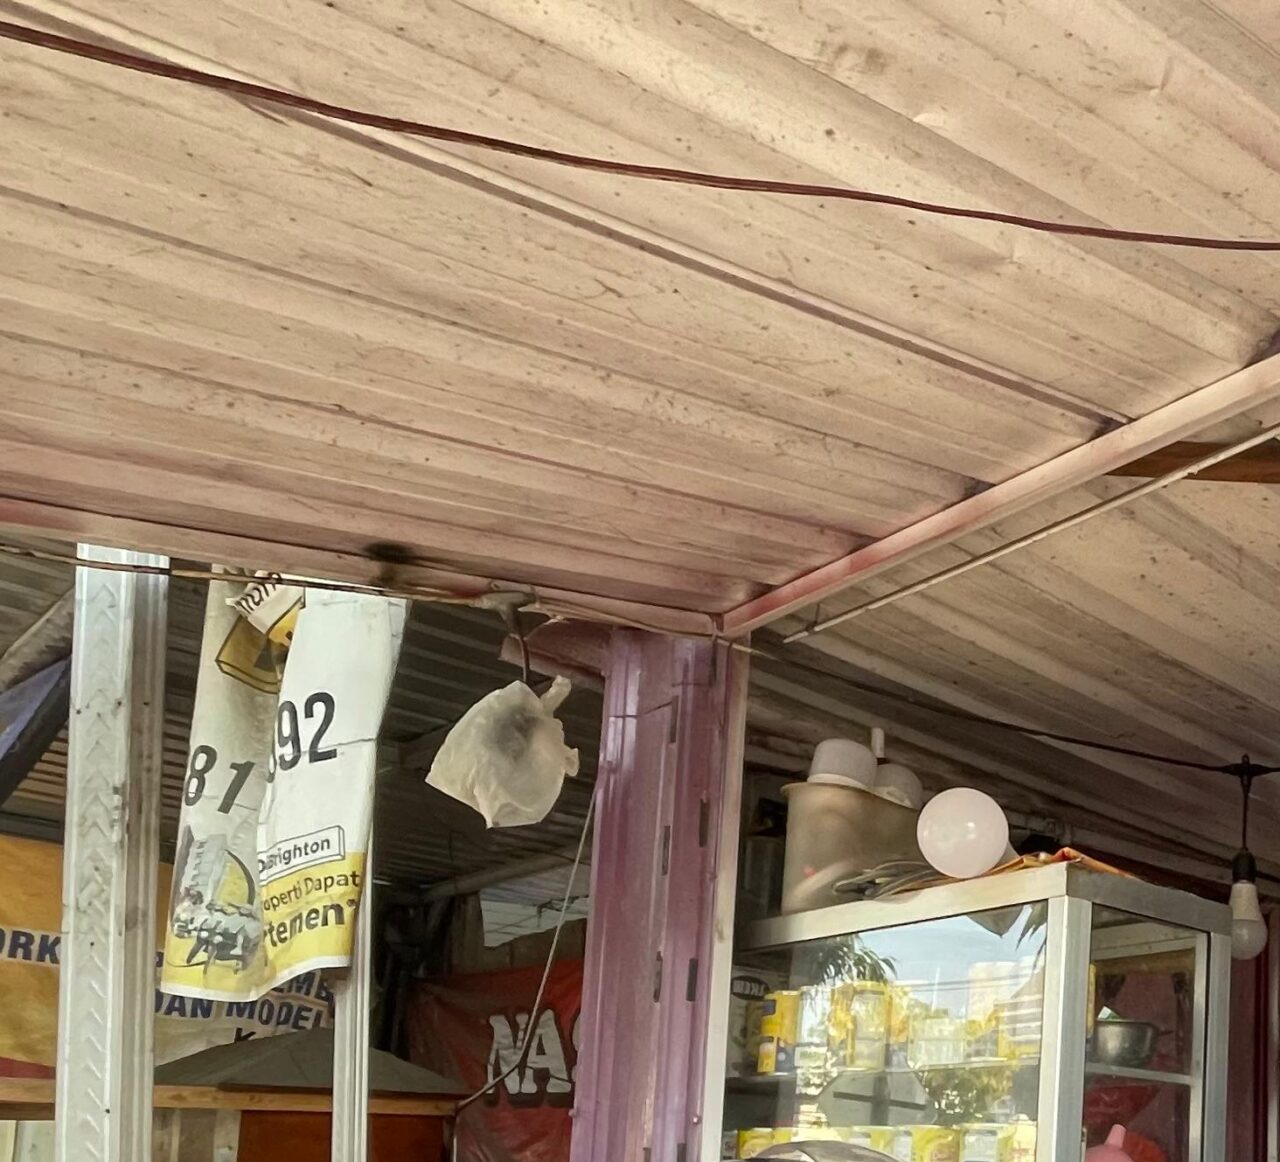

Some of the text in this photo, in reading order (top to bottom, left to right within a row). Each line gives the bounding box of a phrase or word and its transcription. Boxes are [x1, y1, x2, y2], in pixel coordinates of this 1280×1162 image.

[304, 870, 360, 897] Dapat
[0, 928, 61, 964] RK
[487, 1009, 580, 1095] NA
